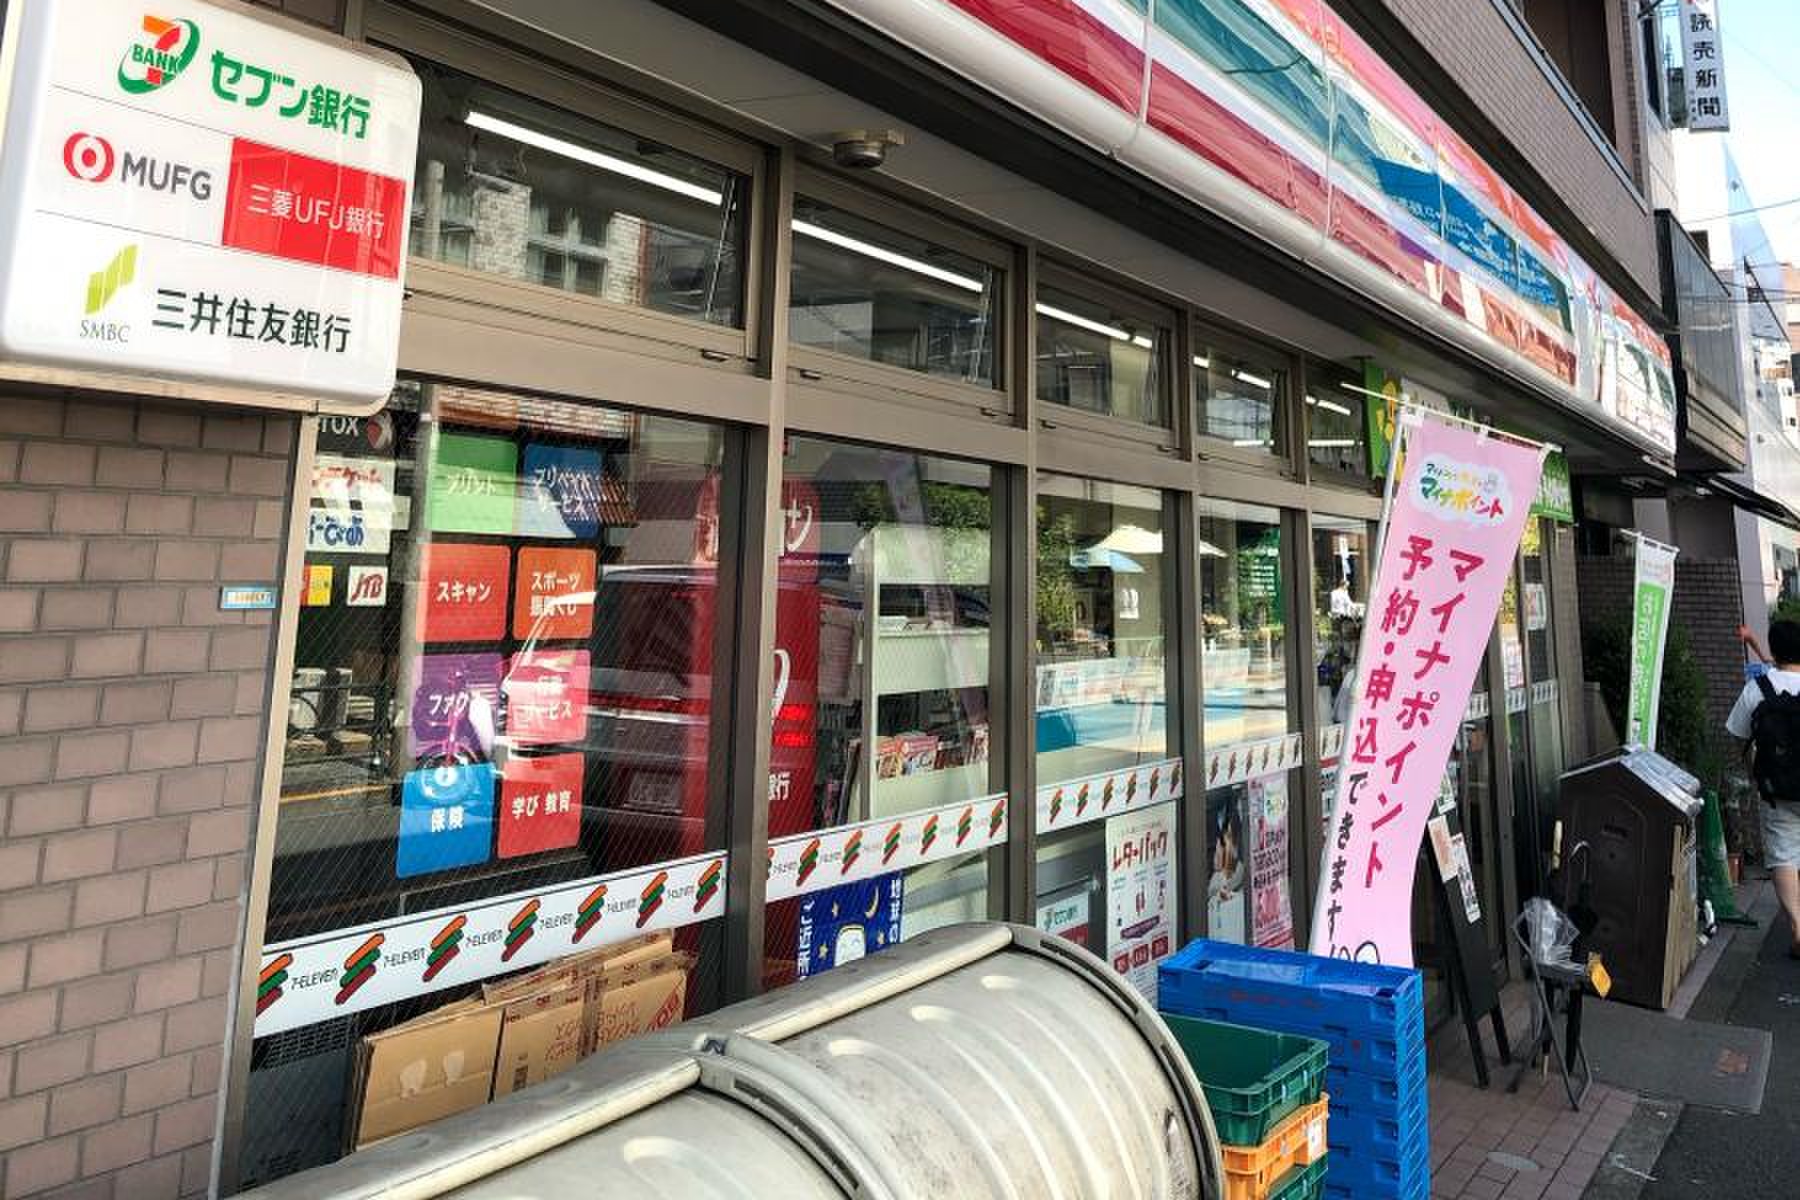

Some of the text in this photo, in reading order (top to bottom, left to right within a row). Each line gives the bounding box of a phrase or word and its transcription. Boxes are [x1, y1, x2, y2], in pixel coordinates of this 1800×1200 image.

[132, 43, 179, 73] BANK
[1690, 13, 1721, 117] 読売新聞
[210, 48, 371, 140] セブン銀行
[121, 151, 212, 201] MUFG
[247, 183, 385, 240] 三菱UFJ銀行
[79, 319, 130, 344] SMBC
[151, 286, 352, 353] 三井住友銀行
[436, 580, 491, 603] スキャン
[530, 570, 581, 592] スポーツ
[1365, 549, 1485, 889] マイナポイント
[430, 805, 465, 833] 保険
[511, 793, 539, 820] 学び
